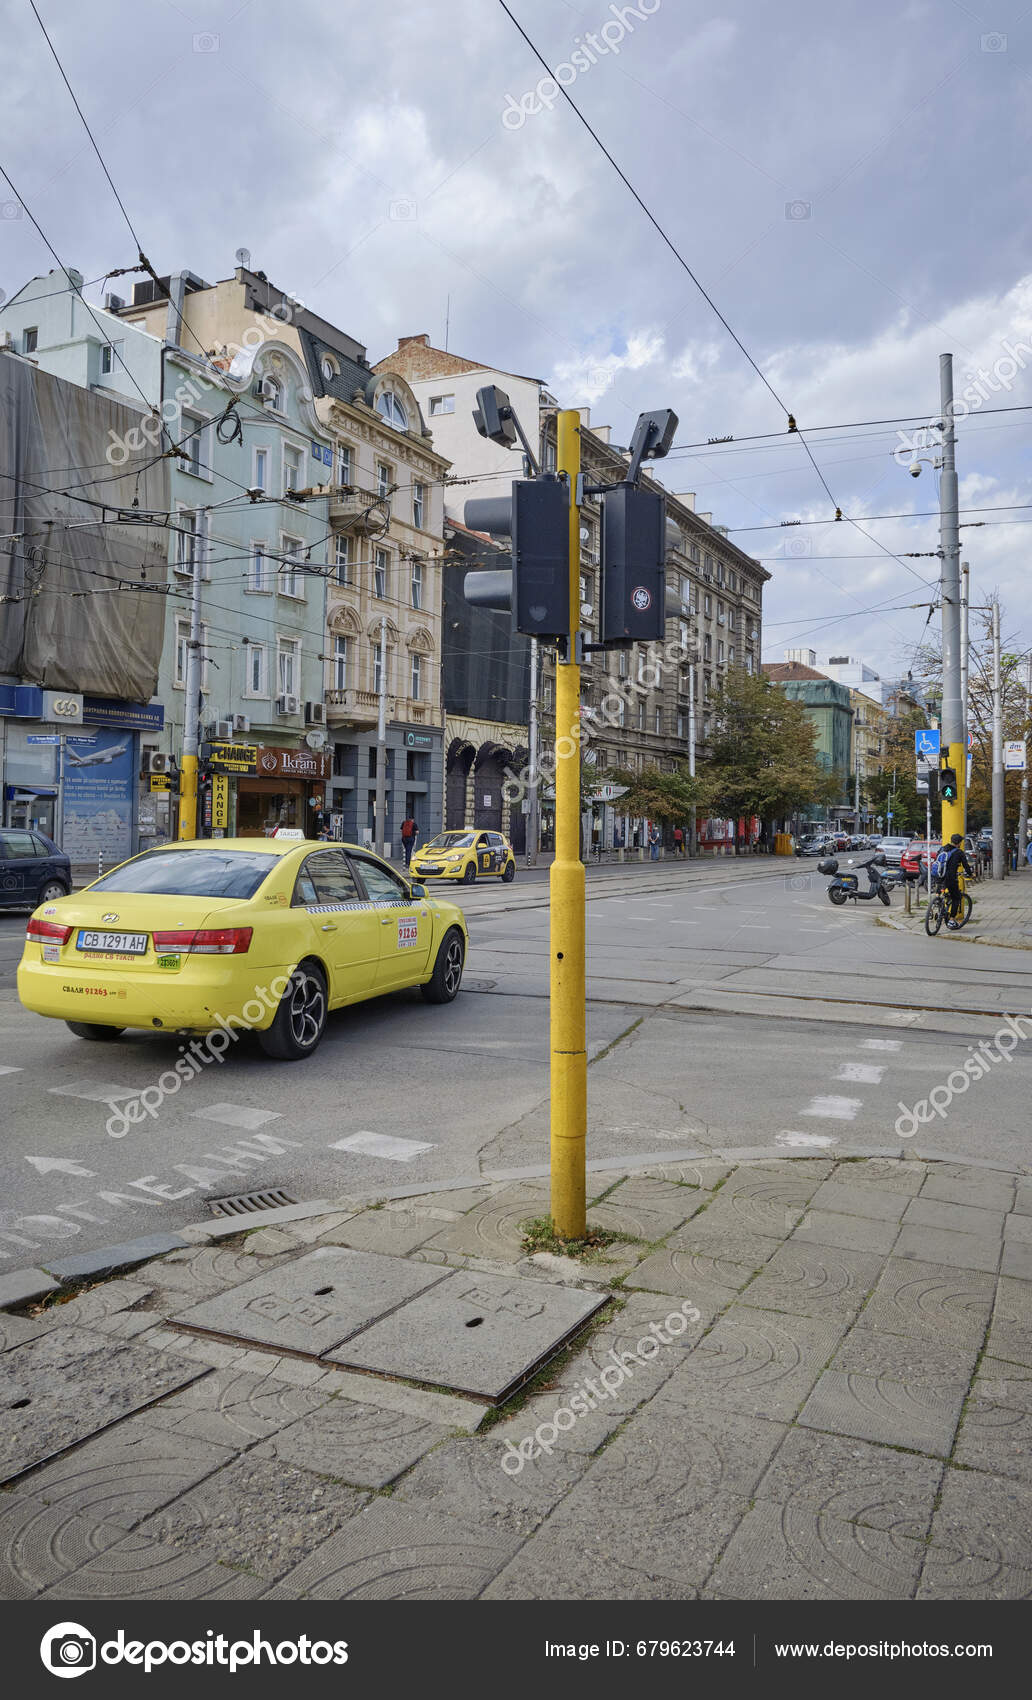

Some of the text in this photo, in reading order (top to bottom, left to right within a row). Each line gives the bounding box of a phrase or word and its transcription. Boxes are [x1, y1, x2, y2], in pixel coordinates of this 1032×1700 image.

[280, 752, 317, 770] Ikram
[216, 775, 225, 826] CHANGE
[103, 935, 127, 948] 1291
[85, 987, 107, 996] 91263
